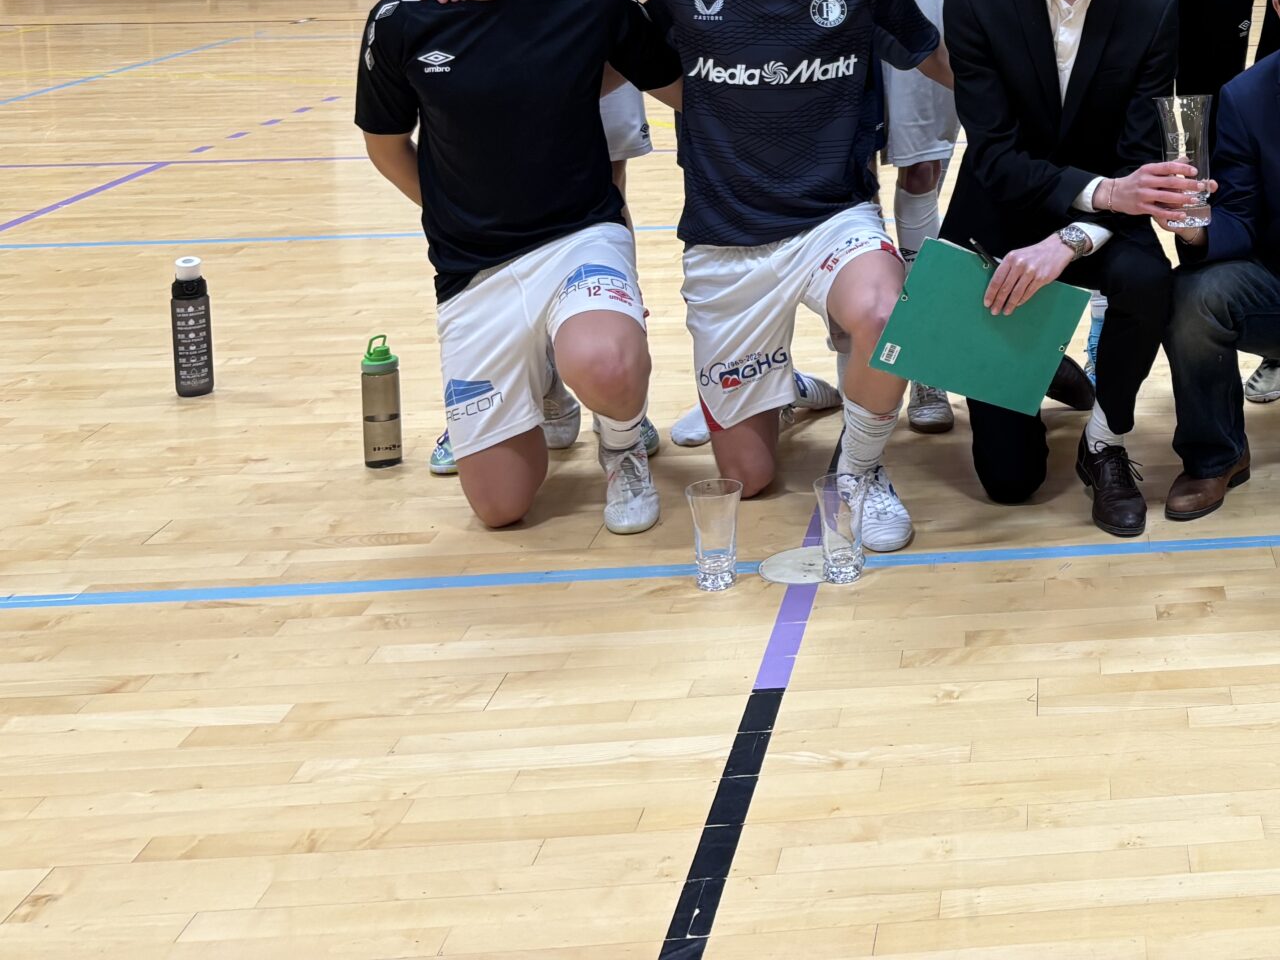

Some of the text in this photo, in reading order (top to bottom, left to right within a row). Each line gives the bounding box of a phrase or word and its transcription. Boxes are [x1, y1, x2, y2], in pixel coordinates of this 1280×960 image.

[688, 53, 858, 86] Media Markt
[587, 285, 602, 297] 12
[741, 346, 788, 380] GHG
